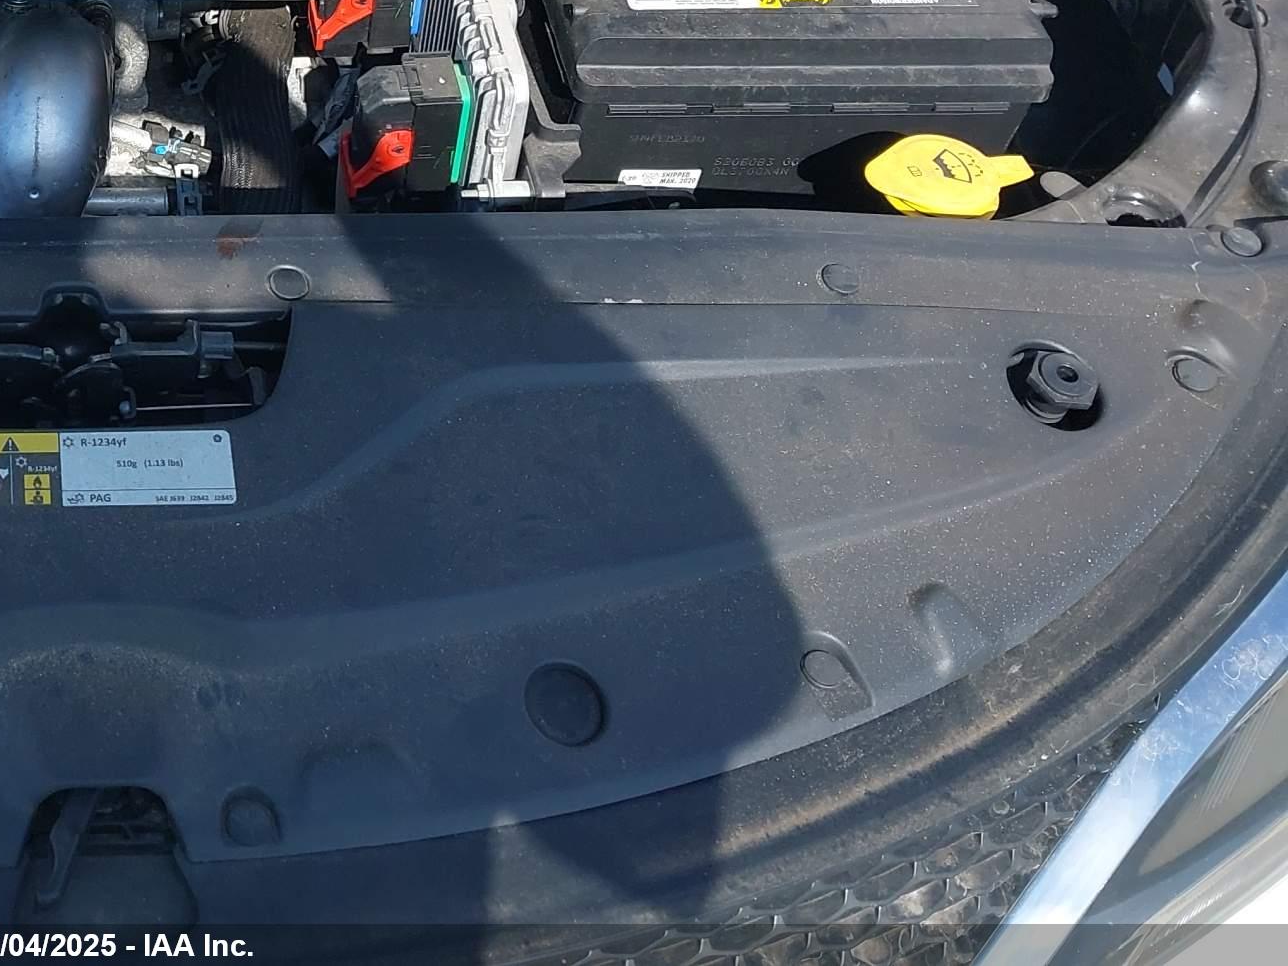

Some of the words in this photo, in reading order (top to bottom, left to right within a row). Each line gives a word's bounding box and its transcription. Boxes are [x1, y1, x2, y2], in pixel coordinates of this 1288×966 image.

[81, 437, 127, 448] R-1234yf
[116, 460, 137, 468] 510g
[143, 458, 166, 468] (1.13
[168, 458, 184, 467] lbs)
[90, 493, 112, 503] PAG
